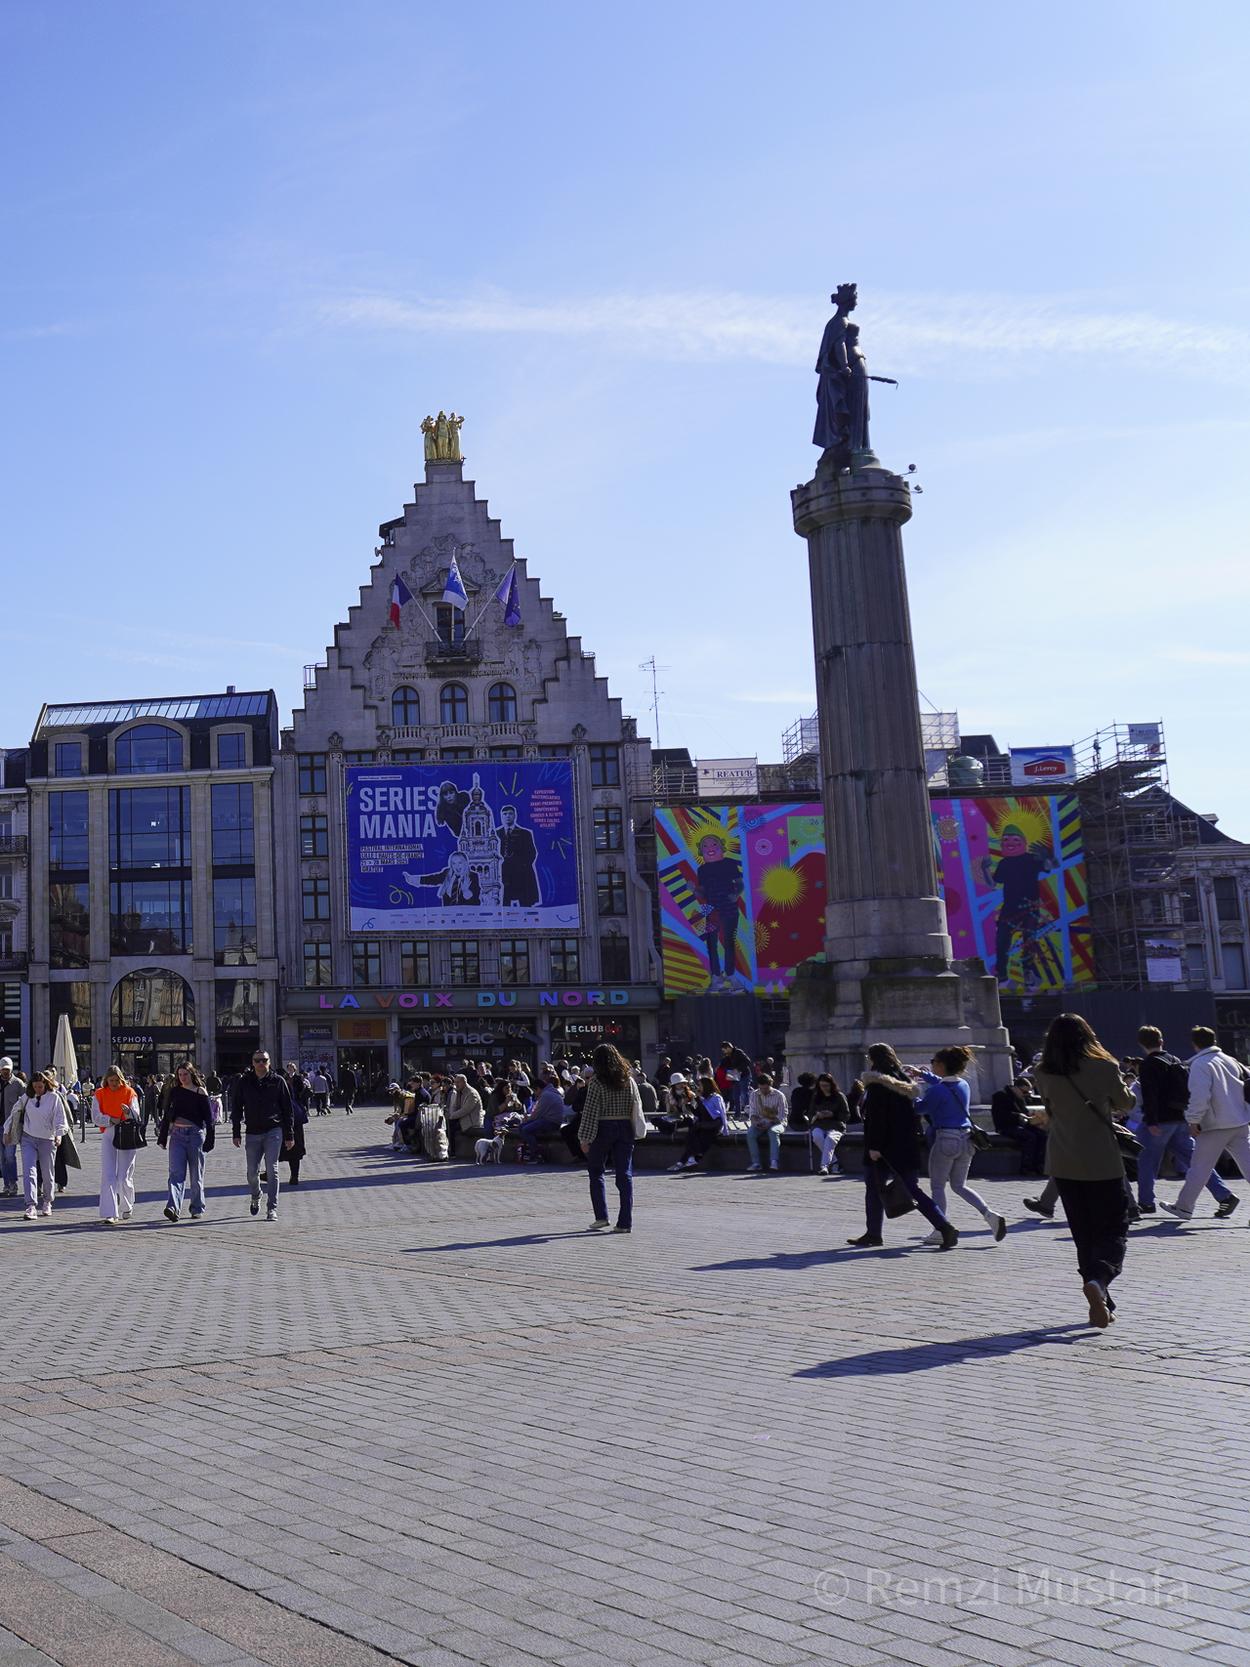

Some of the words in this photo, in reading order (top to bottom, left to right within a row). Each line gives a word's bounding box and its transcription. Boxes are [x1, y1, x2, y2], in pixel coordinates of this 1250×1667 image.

[359, 785, 440, 812] SERIES
[359, 813, 437, 839] MANIA
[320, 994, 360, 1009] LA
[375, 993, 454, 1008] VOIX
[478, 992, 517, 1007] DU
[540, 990, 630, 1006] NORD
[443, 1030, 495, 1045] fnac
[565, 1025, 577, 1033] LE
[578, 1025, 604, 1033] CLUB
